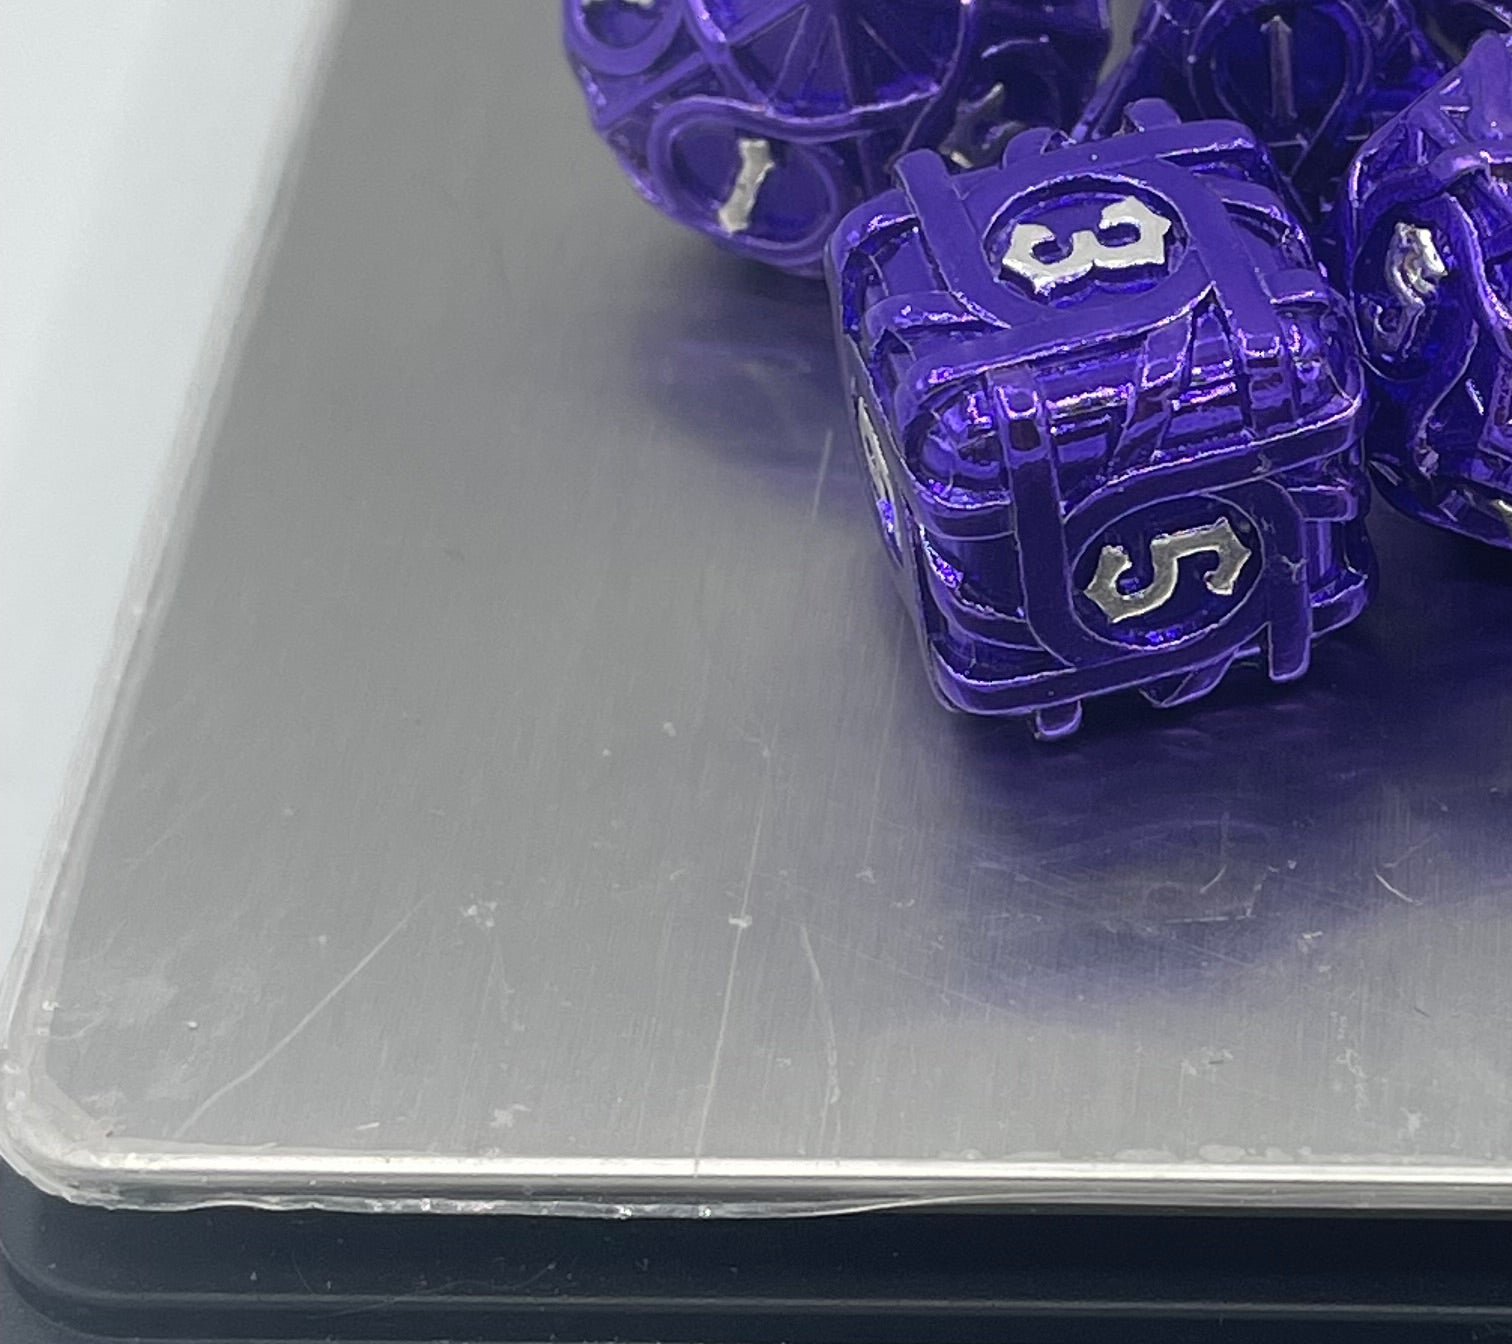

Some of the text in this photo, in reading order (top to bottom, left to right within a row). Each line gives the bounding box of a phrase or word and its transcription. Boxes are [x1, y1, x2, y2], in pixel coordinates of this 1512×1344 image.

[718, 138, 775, 234] 1
[1001, 195, 1172, 295] 3
[1084, 517, 1252, 624] 5
